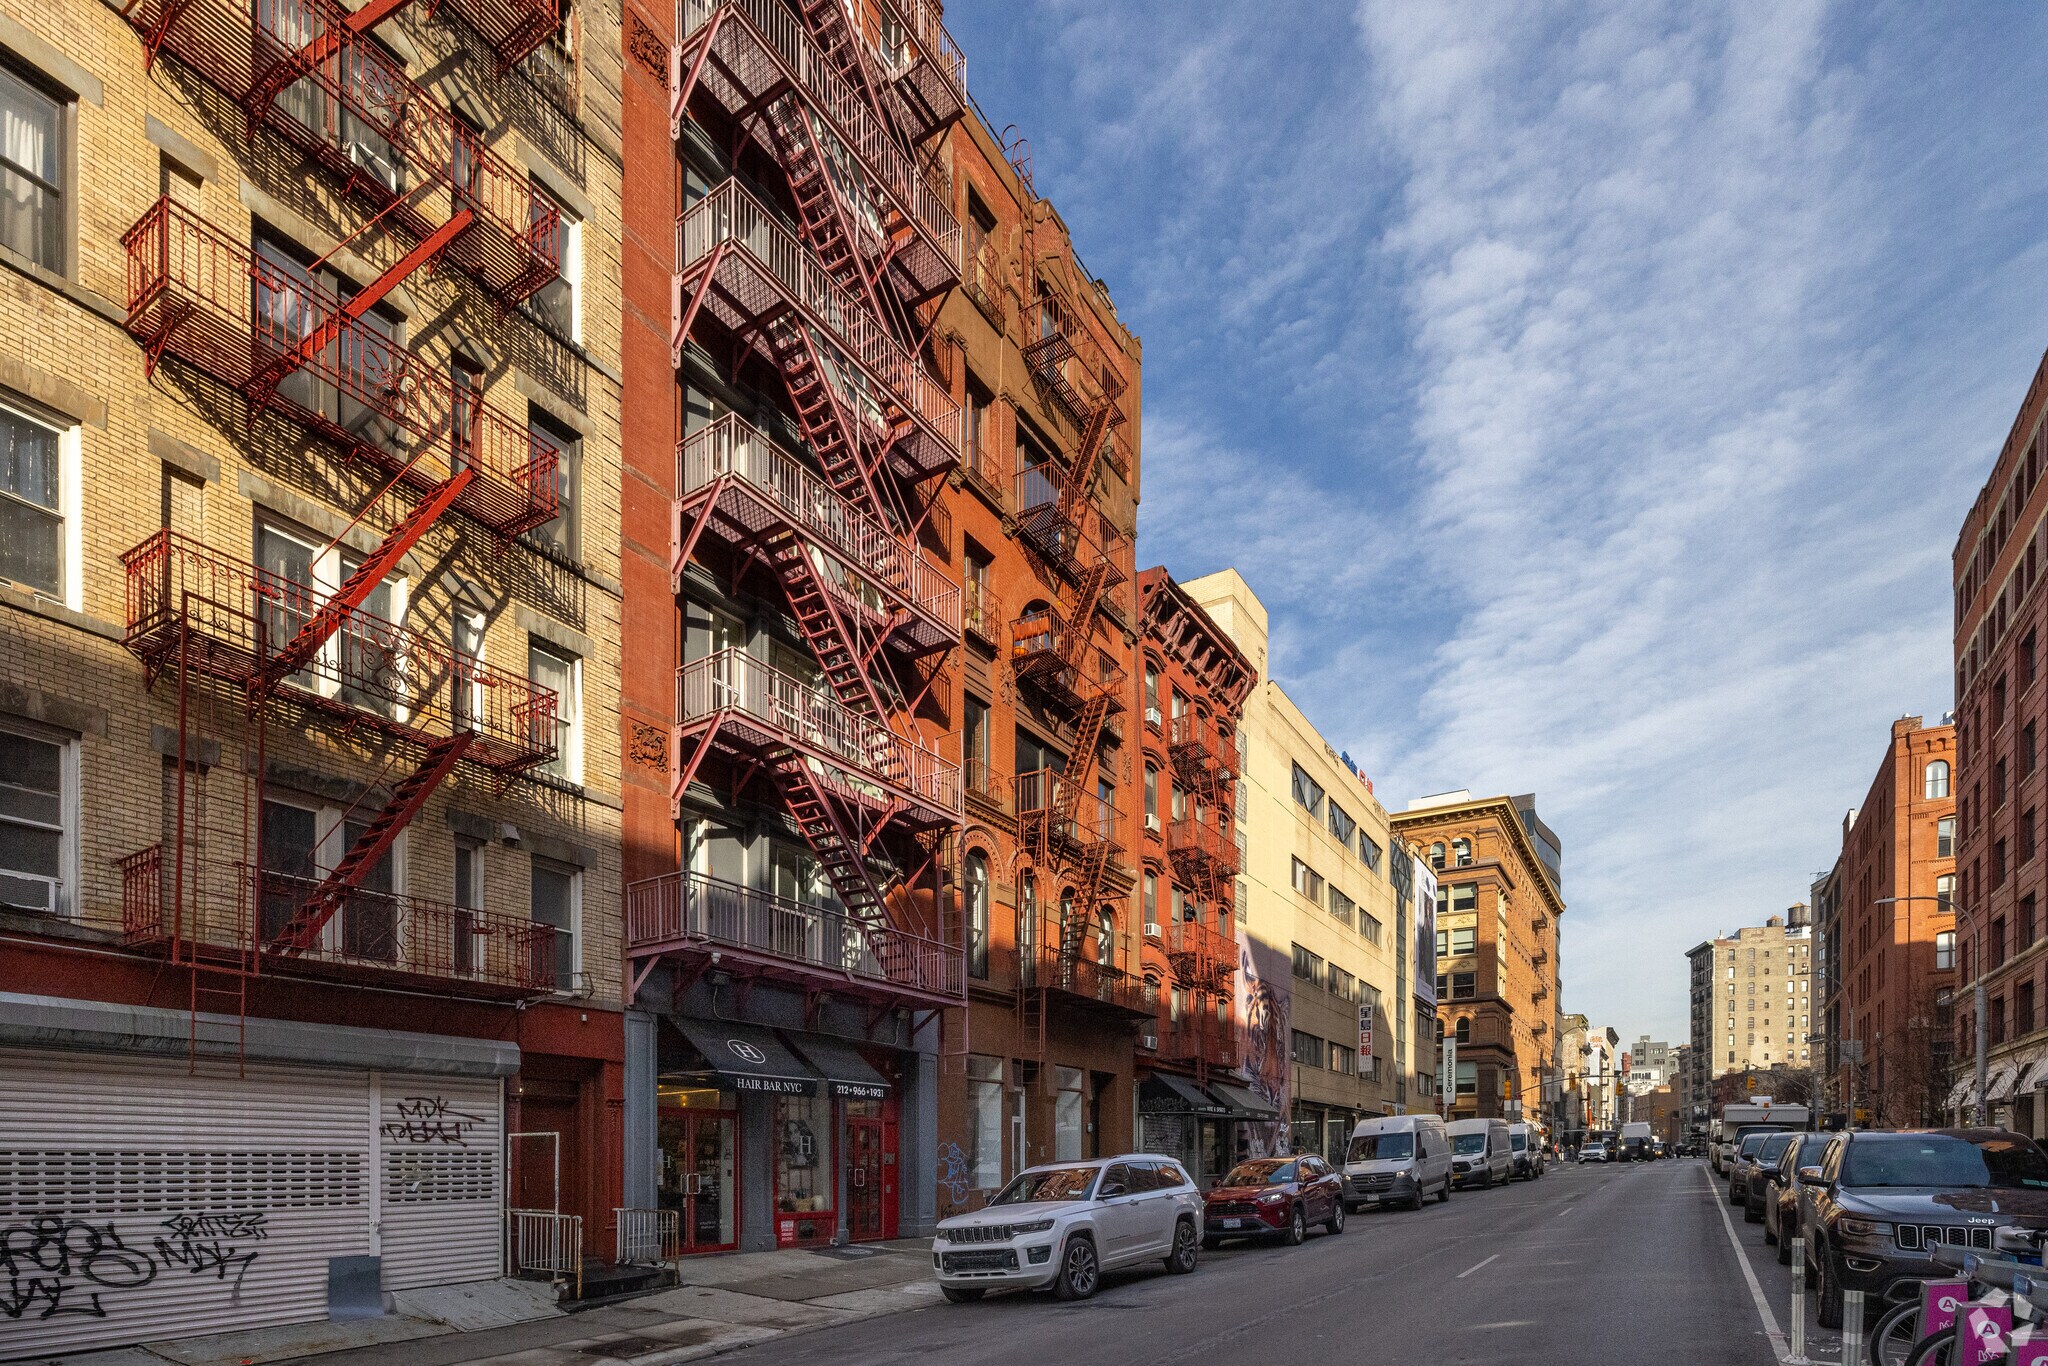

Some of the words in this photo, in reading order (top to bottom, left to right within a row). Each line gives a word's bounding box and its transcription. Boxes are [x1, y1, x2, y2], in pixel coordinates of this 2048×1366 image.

[1360, 1006, 1371, 1057] 星島日報
[733, 1043, 761, 1060] H
[737, 1078, 762, 1091] HAIR
[763, 1080, 782, 1092] BAR
[783, 1082, 802, 1093] NYC
[800, 1135, 812, 1155] H
[1968, 1216, 1995, 1225] Jeep
[1942, 1299, 1954, 1309] A
[1982, 1323, 1996, 1335] A
